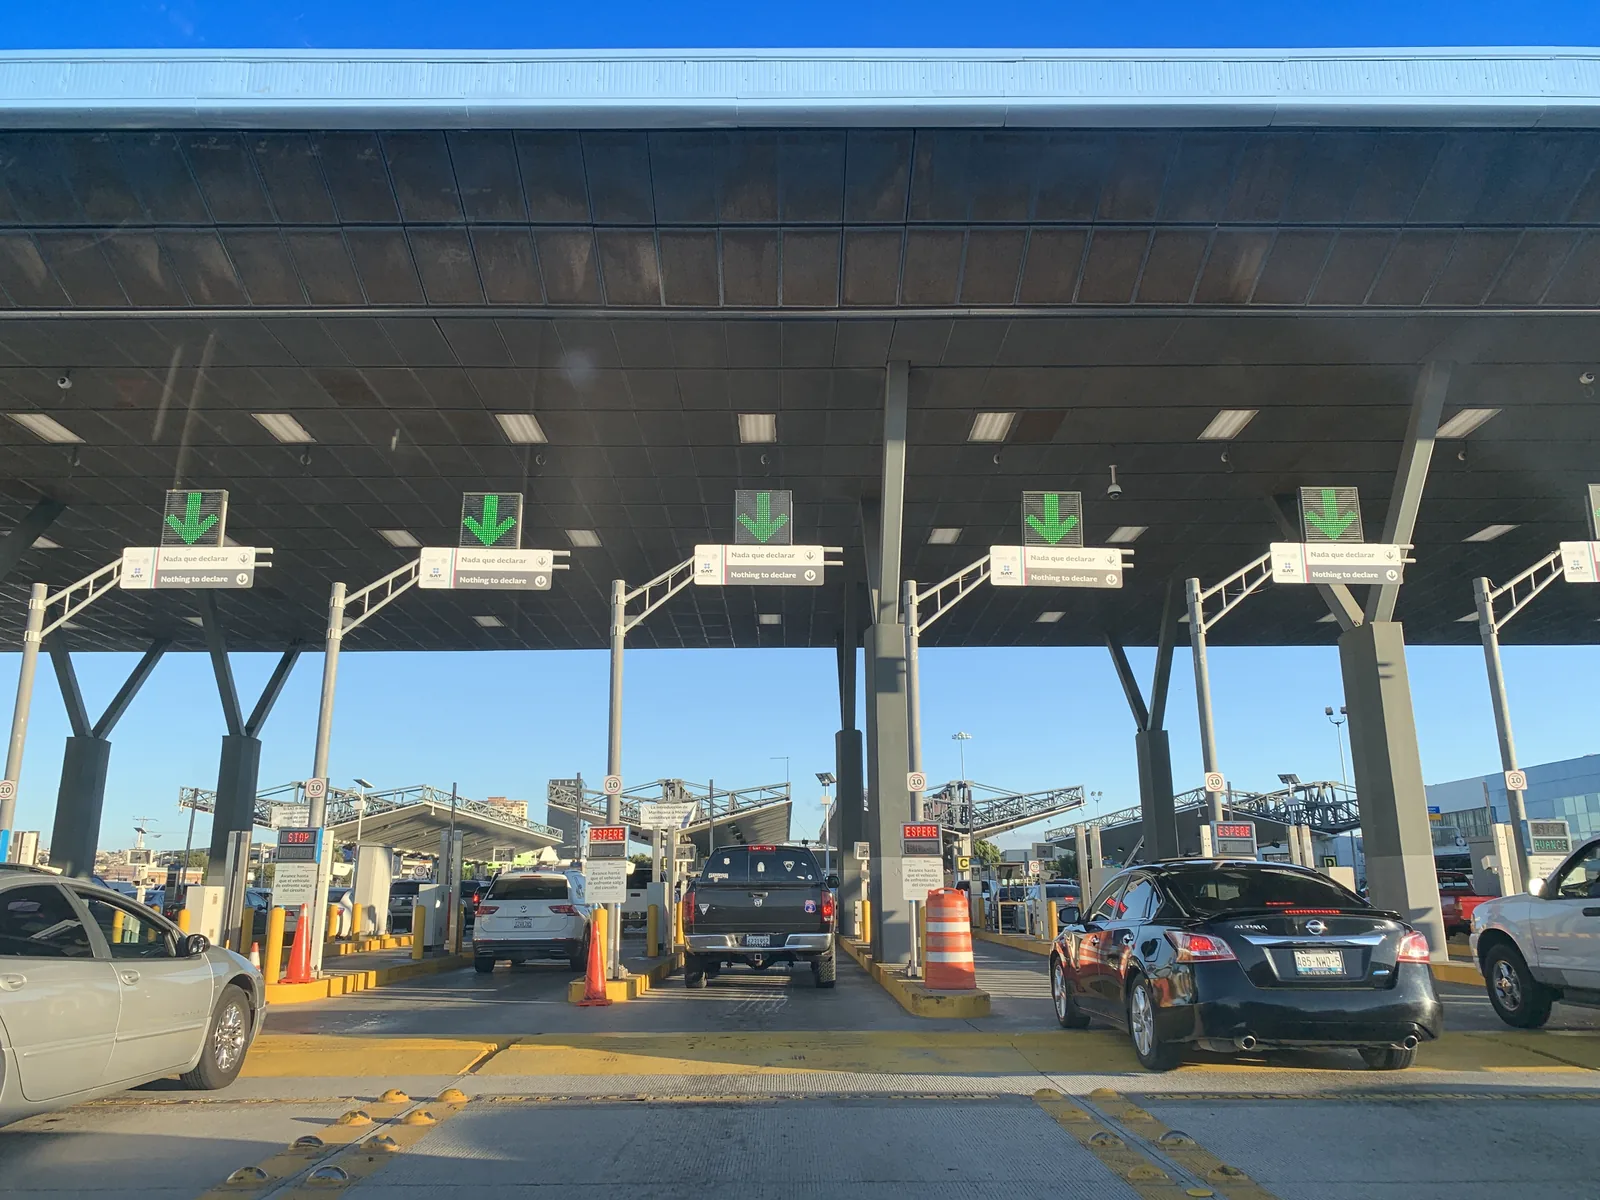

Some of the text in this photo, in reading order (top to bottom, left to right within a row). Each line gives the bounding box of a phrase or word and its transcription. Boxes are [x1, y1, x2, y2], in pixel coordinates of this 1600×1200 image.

[1051, 555, 1064, 563] que
[1345, 551, 1375, 559] declarar
[160, 575, 190, 584] Nothing
[200, 575, 228, 583] declare
[730, 571, 760, 580] Nothing
[770, 571, 797, 579] declare
[1031, 574, 1061, 583] Nothing
[1070, 574, 1098, 582] declare
[1312, 570, 1342, 580] Nothing
[459, 576, 490, 585] Nothing
[490, 576, 499, 584] to
[591, 829, 624, 840] ESPERE
[905, 826, 937, 837] ESPERE
[1217, 825, 1251, 837] ESPERE
[288, 832, 310, 843] STOP
[1534, 840, 1567, 850] AVANCE
[960, 858, 968, 868] C
[1325, 858, 1334, 867] D
